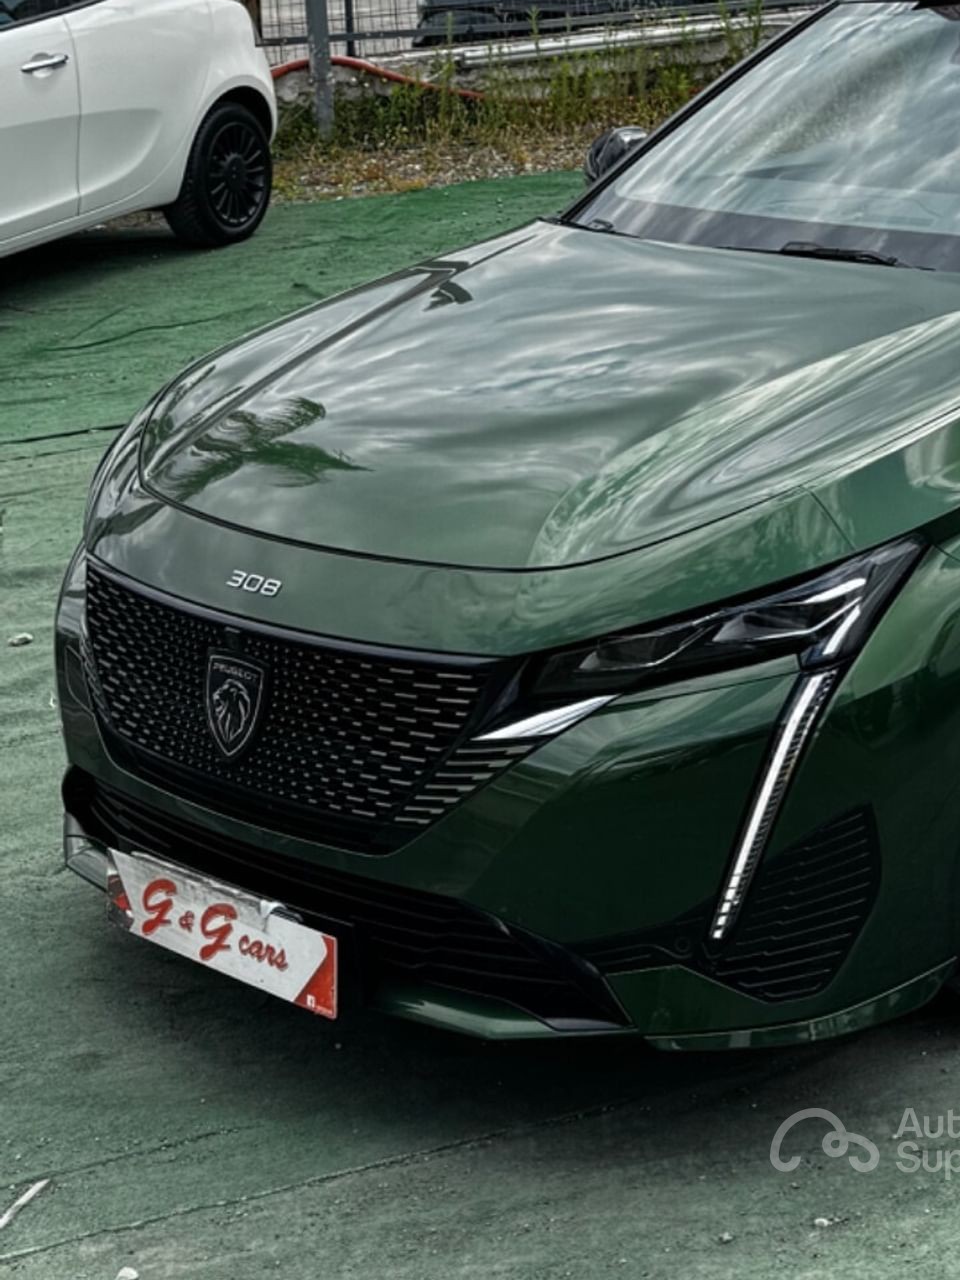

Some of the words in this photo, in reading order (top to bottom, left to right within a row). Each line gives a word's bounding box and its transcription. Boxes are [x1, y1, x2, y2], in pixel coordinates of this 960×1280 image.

[225, 569, 283, 597] 308
[140, 877, 178, 936] G
[178, 911, 196, 933] &
[199, 902, 238, 962] G
[238, 934, 289, 972] cars
